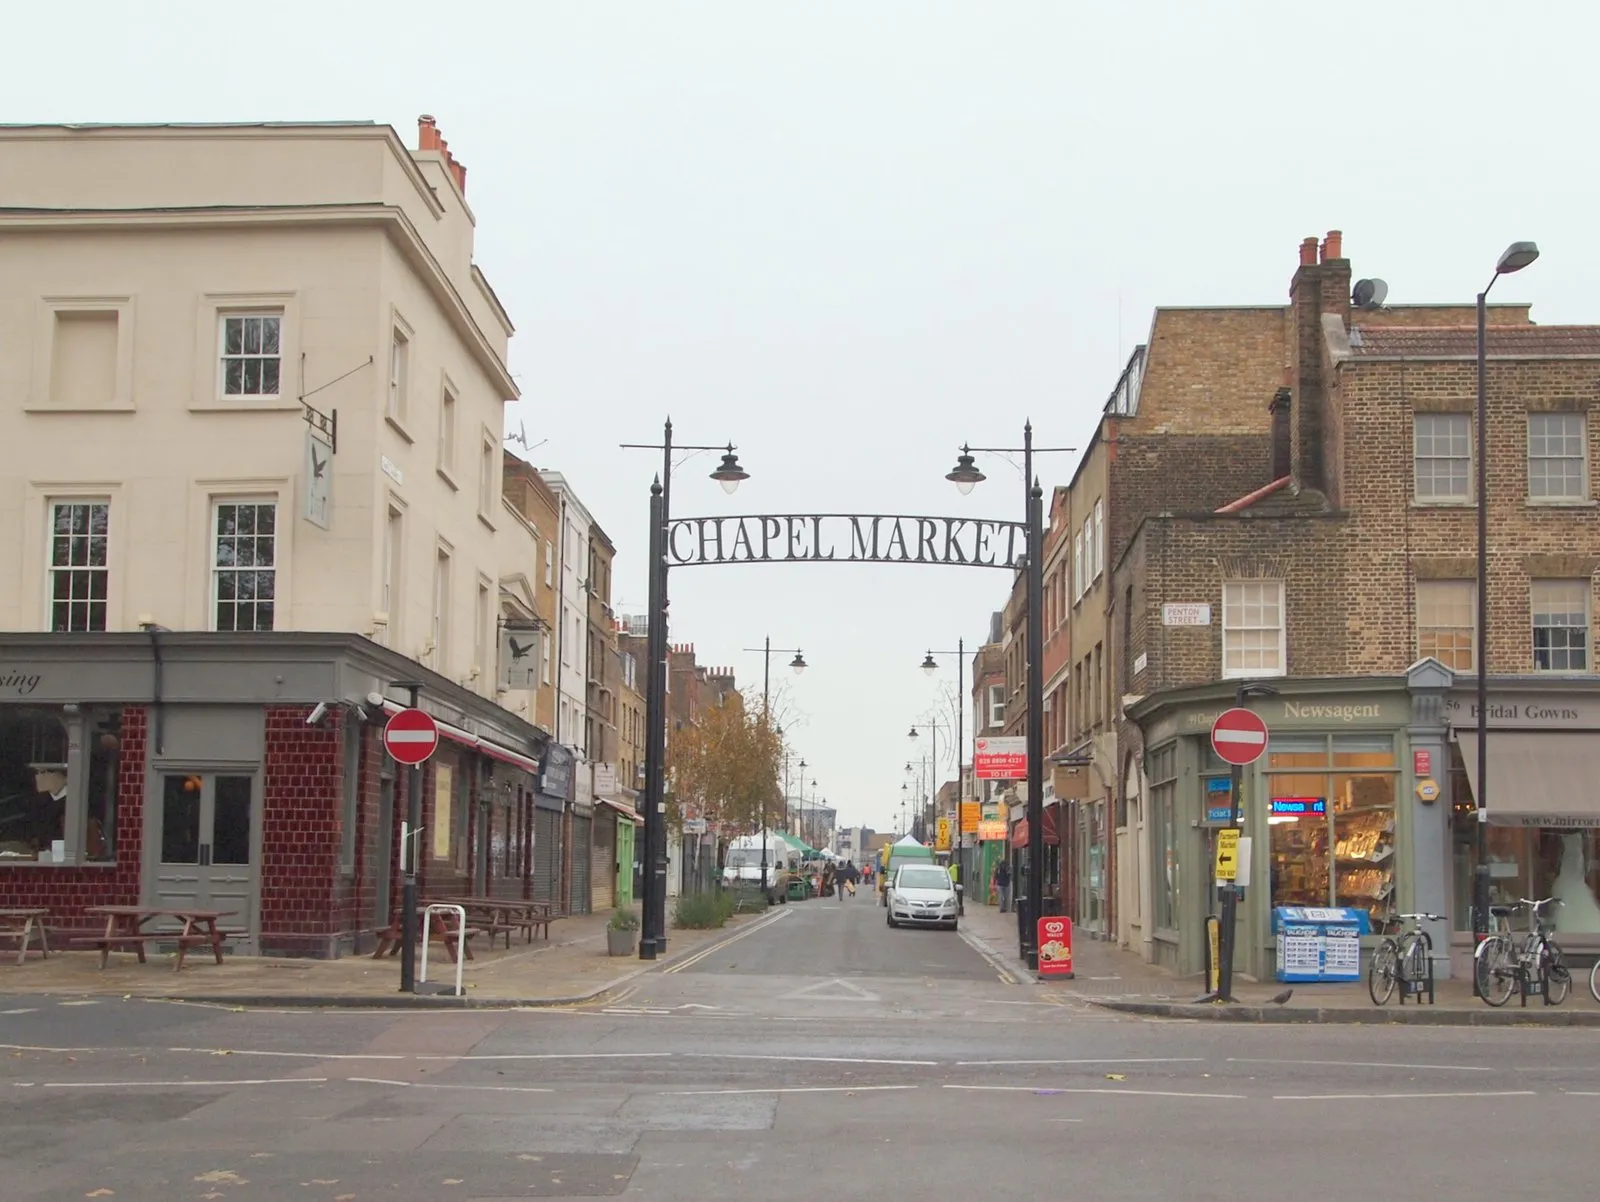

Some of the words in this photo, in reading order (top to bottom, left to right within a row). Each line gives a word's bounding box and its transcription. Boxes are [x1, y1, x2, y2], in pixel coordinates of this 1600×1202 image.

[669, 515, 835, 563] CHAPEL
[848, 516, 1027, 566] MARKET
[1168, 607, 1200, 616] PENTON
[1168, 616, 1197, 624] STREET
[1284, 701, 1380, 721] Newsagent
[1446, 700, 1460, 711] 56
[1525, 705, 1579, 719] Gowns
[939, 823, 947, 845] DIY
